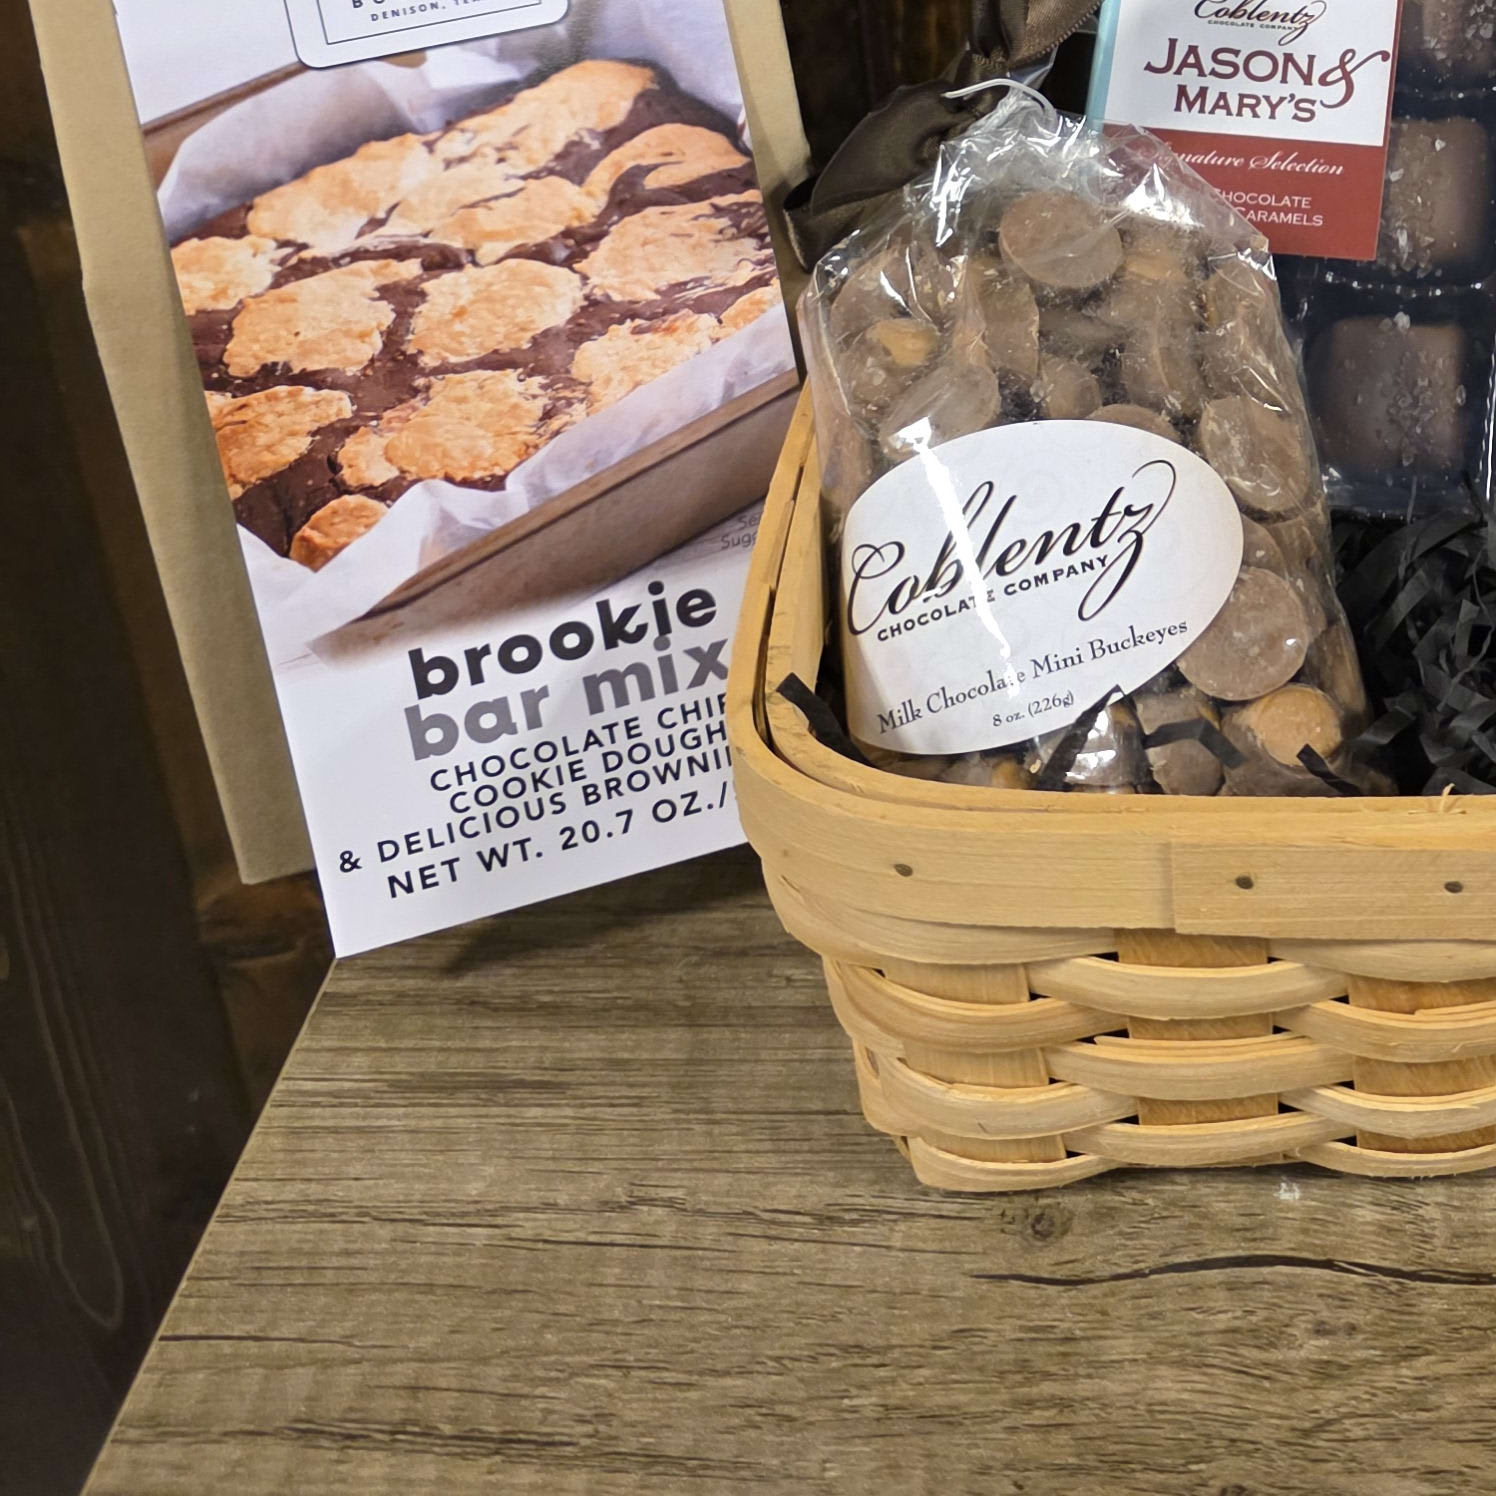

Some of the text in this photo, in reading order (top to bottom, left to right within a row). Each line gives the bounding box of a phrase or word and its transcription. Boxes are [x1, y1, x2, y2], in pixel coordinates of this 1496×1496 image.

[371, 1, 446, 21] DENISON,
[1208, 20, 1255, 28] CHOCOLATE
[1144, 38, 1390, 109] JASON &
[1174, 84, 1316, 123] MARY'S
[1250, 152, 1344, 175] Selection
[847, 459, 1176, 636] Coblentz
[1004, 554, 1108, 596] COMPANY
[408, 580, 718, 699] brookie
[877, 696, 923, 734] Milk
[1031, 647, 1084, 680] Mini
[1089, 619, 1188, 661] Buckeyes
[404, 635, 729, 761] bar mix
[992, 690, 1075, 727] 8 oz. (226g)
[430, 716, 643, 791] CHOCOLATE
[449, 720, 727, 814] COOKIE DOUGH
[339, 849, 363, 874] &
[377, 791, 567, 863] DELICIOUS
[387, 858, 461, 899] NET
[476, 837, 543, 873] WT.
[559, 808, 635, 852] 20.7
